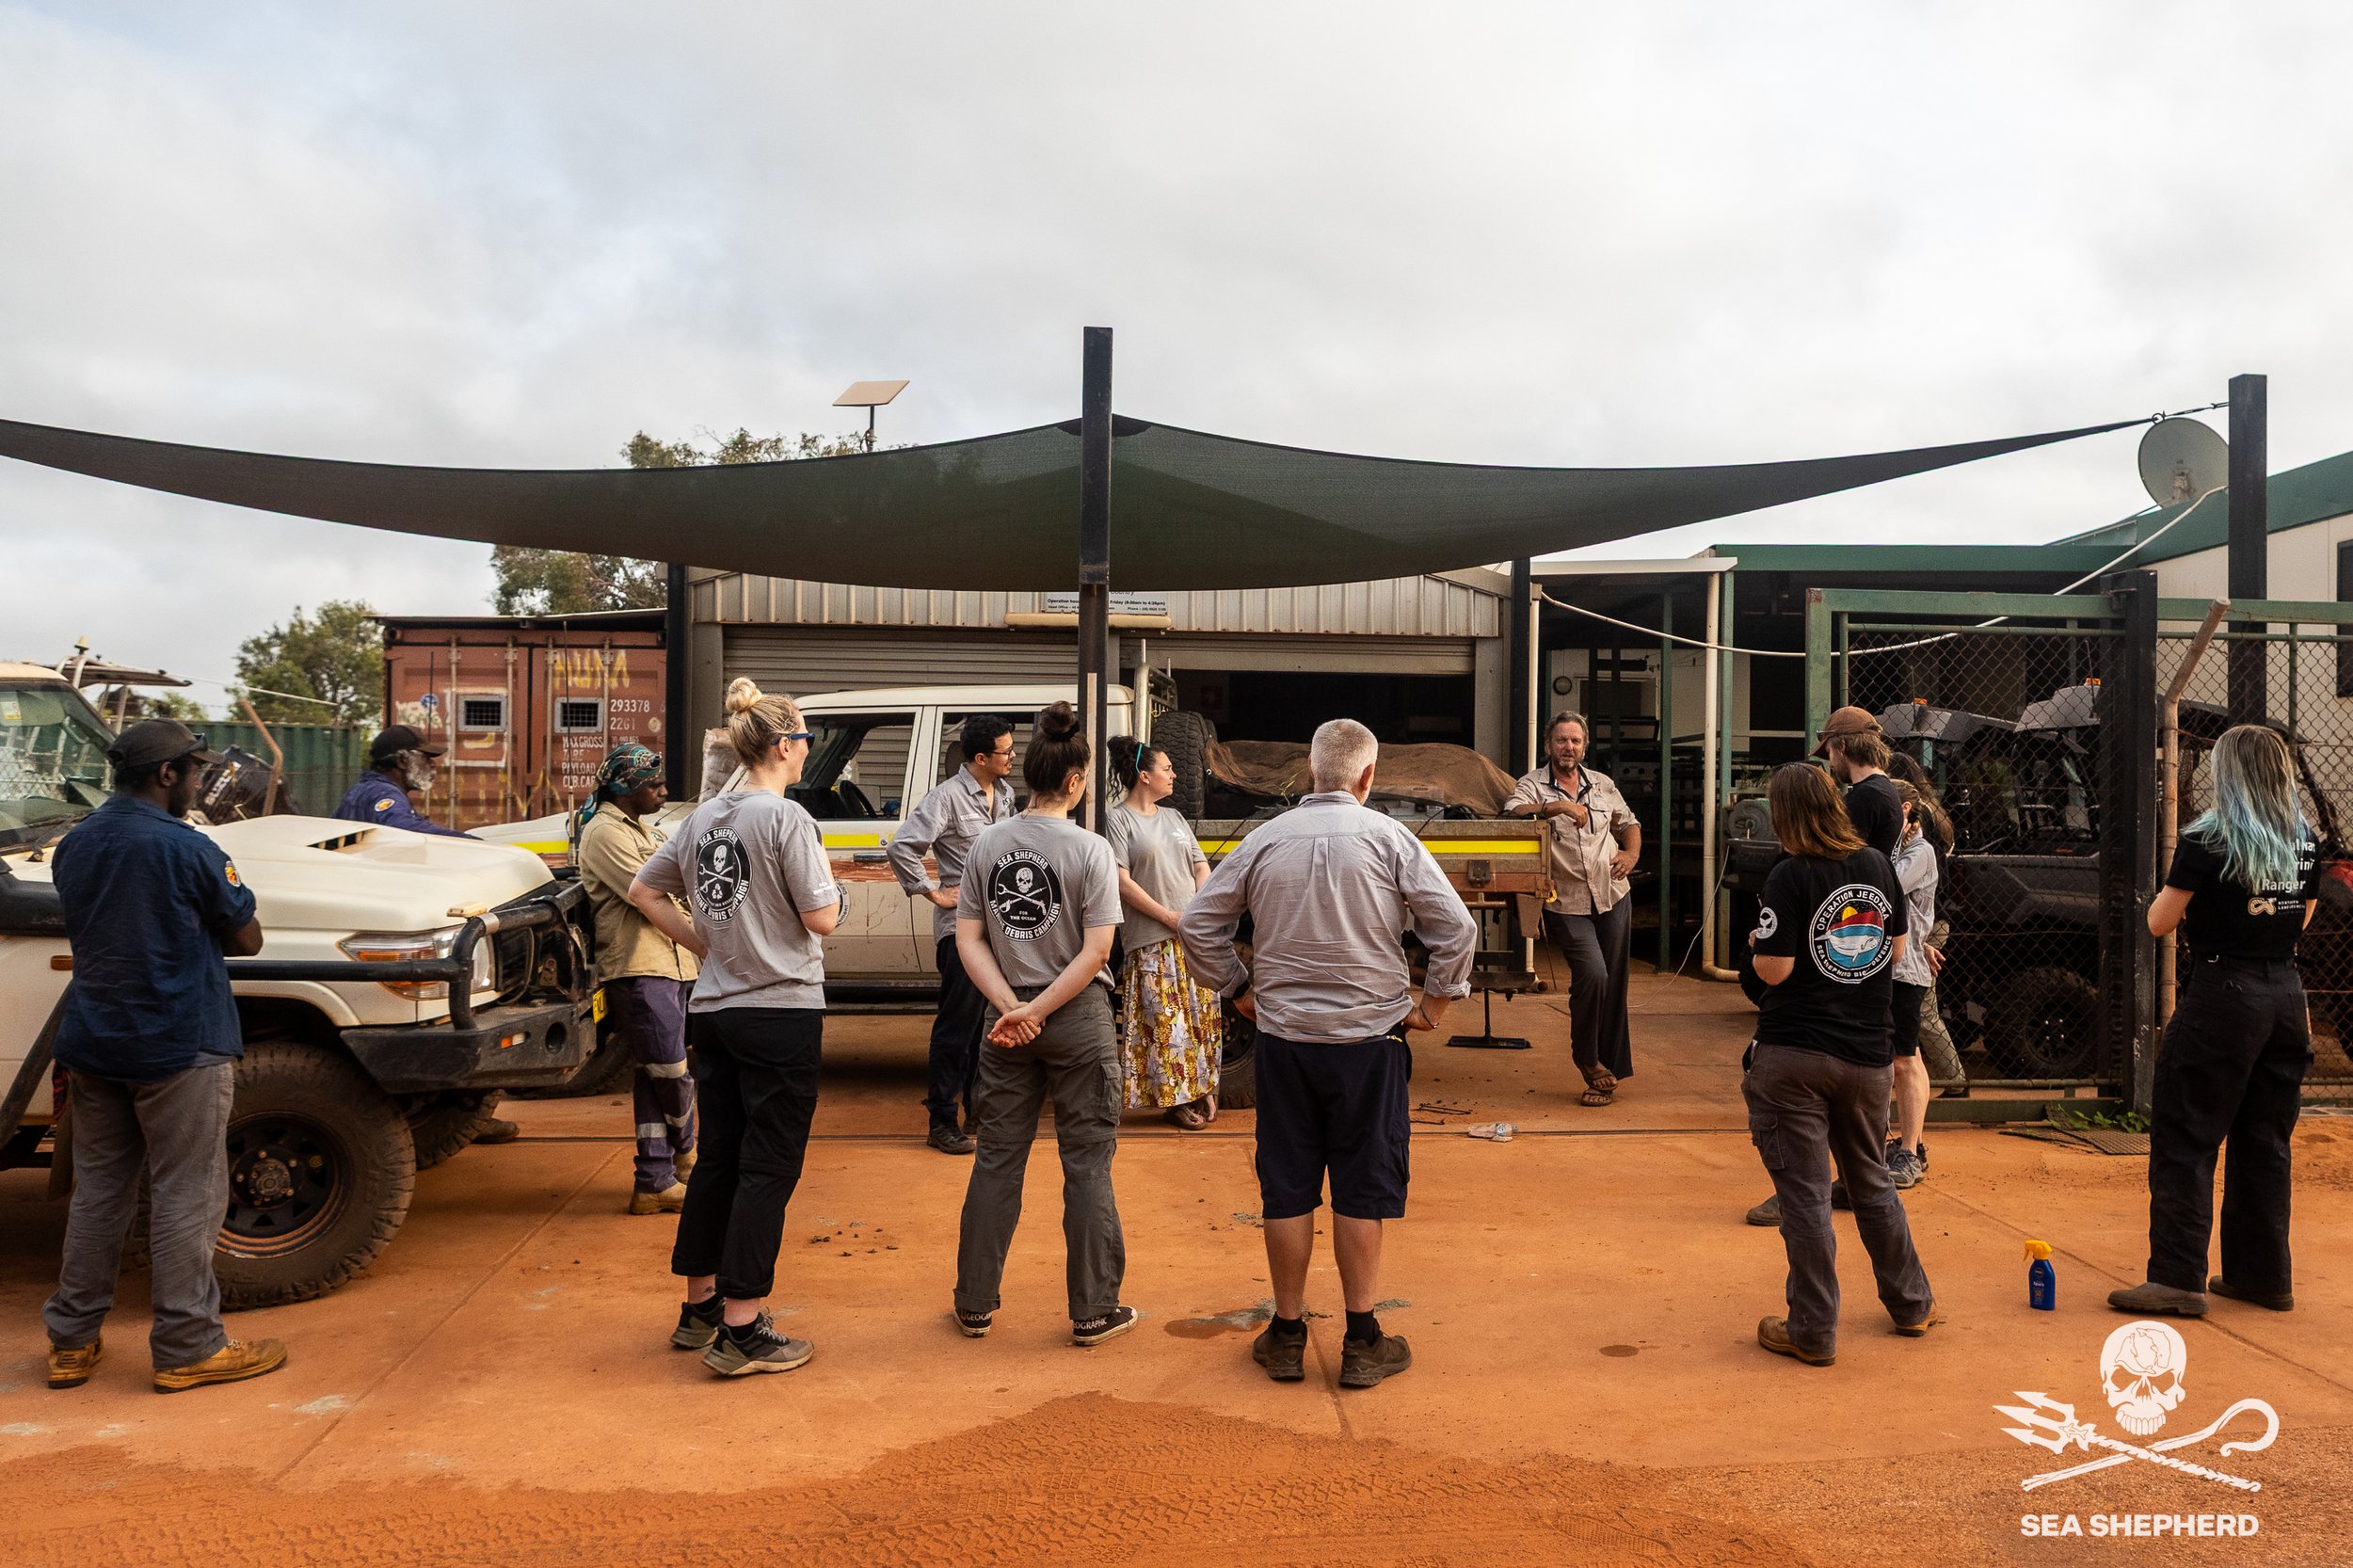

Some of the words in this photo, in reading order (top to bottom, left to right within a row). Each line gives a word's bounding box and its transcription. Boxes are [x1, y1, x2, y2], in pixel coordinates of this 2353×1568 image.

[610, 698, 650, 713] 293378
[610, 716, 636, 730] 22G1
[578, 736, 603, 748] GROSS
[561, 761, 597, 775] PAYLOAD
[698, 833, 712, 847] SEA
[997, 854, 1014, 868] SEA
[1015, 851, 1048, 870] SHEPHERD
[2262, 878, 2306, 893] Ranger
[1817, 890, 1854, 931] OPERATION
[1856, 889, 1890, 920] JEEDARA
[1004, 926, 1033, 939] DEBRIS
[1034, 903, 1061, 937] CAMPAIGN
[1817, 944, 1826, 960] SEA
[1871, 936, 1893, 967] DEFENCE
